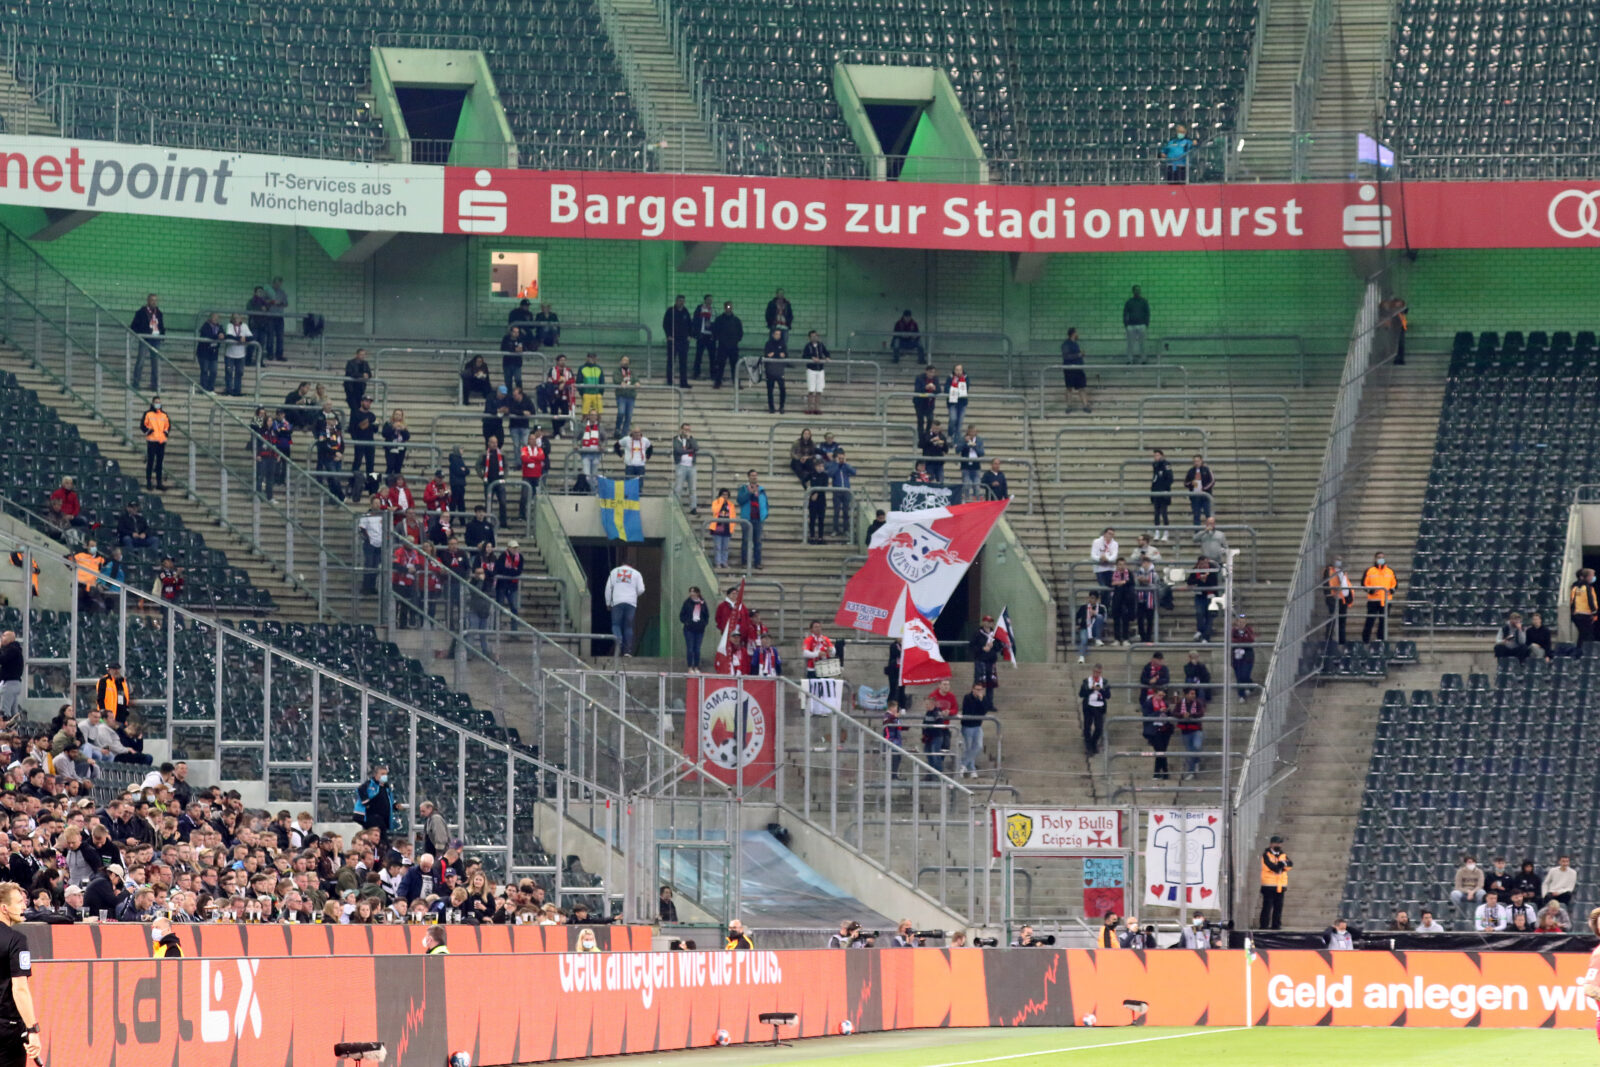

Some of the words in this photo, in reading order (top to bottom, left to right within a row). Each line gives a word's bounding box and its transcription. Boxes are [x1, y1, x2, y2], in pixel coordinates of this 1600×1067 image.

[264, 172, 356, 194] IT-Services
[361, 182, 392, 195] aus
[250, 191, 407, 216] Mönchengladbach
[550, 184, 827, 236] Bargeldlos
[845, 202, 926, 235] zur
[943, 197, 1303, 239] Stadionwurst
[1041, 815, 1073, 832] Holy
[1079, 815, 1113, 831] Bulls
[1186, 811, 1204, 820] Best
[1042, 833, 1082, 848] Leipzig
[1268, 974, 1352, 1008] Geld
[1363, 975, 1528, 1018] anlegen
